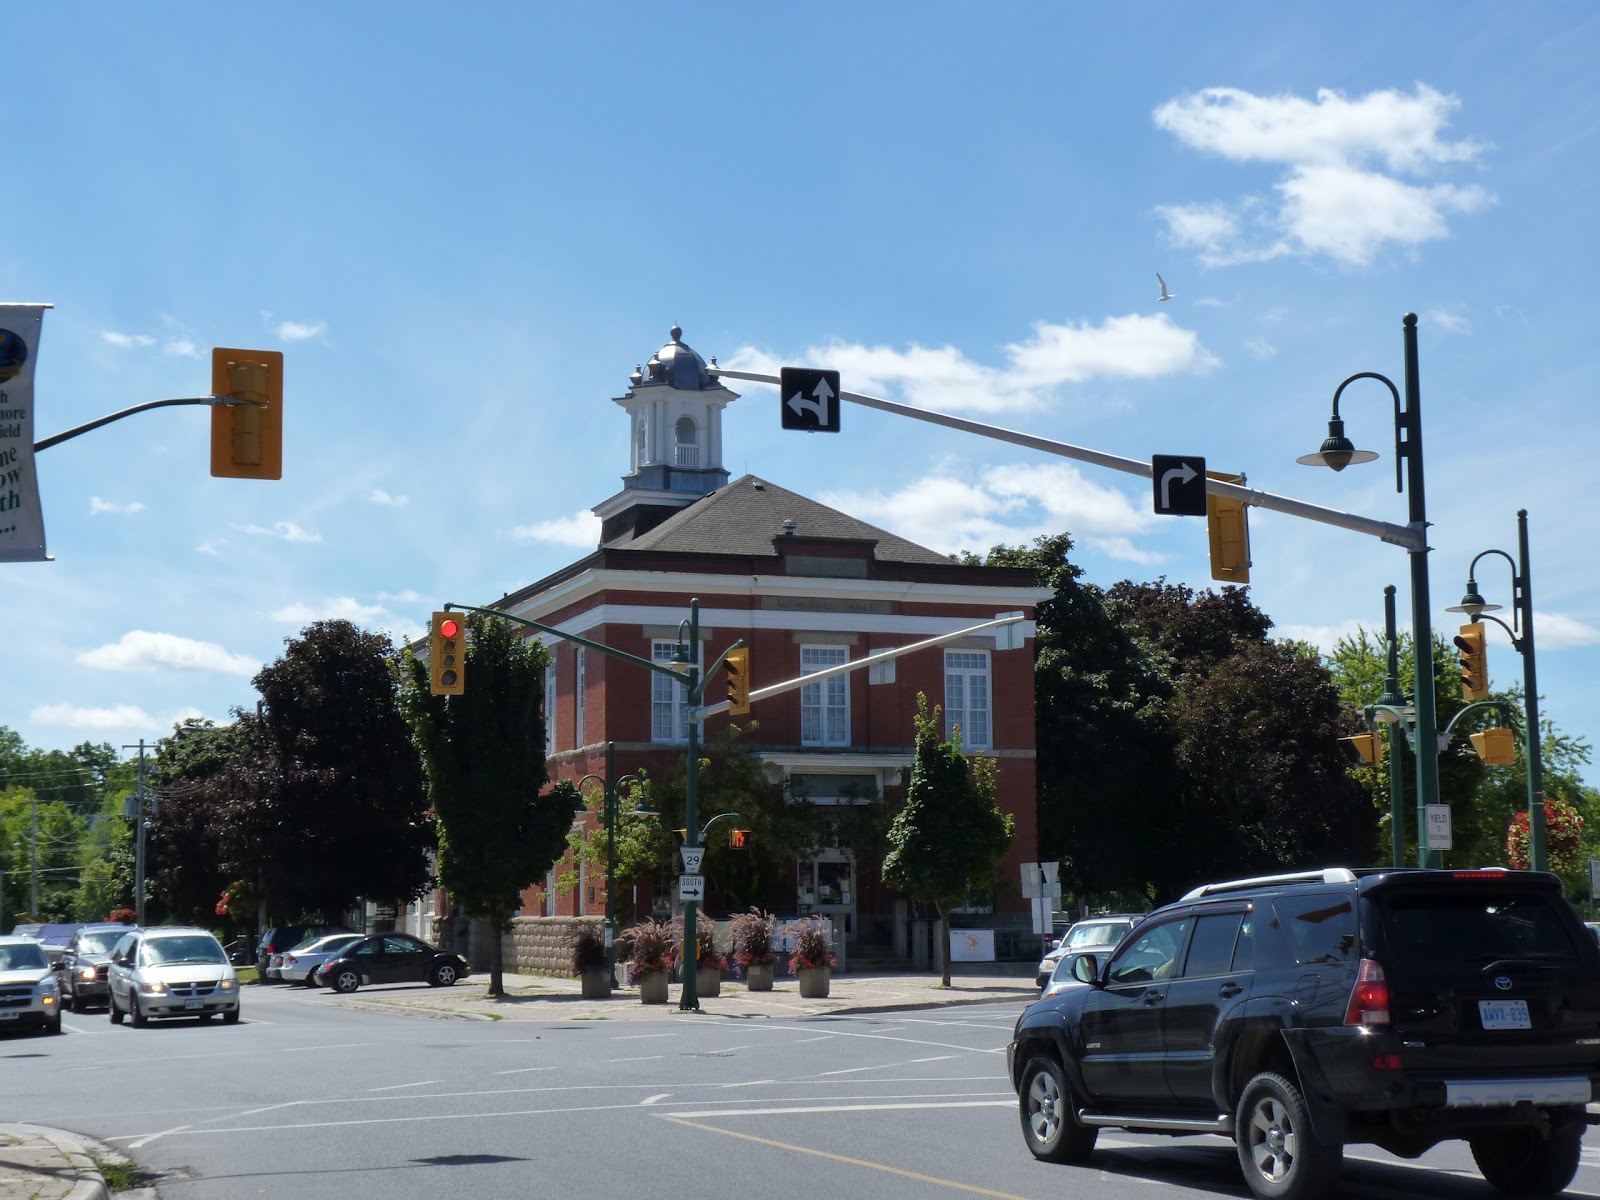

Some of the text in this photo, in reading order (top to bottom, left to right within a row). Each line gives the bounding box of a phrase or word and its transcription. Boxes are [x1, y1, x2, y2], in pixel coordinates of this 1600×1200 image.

[1429, 814, 1447, 823] YIELD
[686, 855, 699, 865] 29
[682, 878, 702, 886] SOUTH
